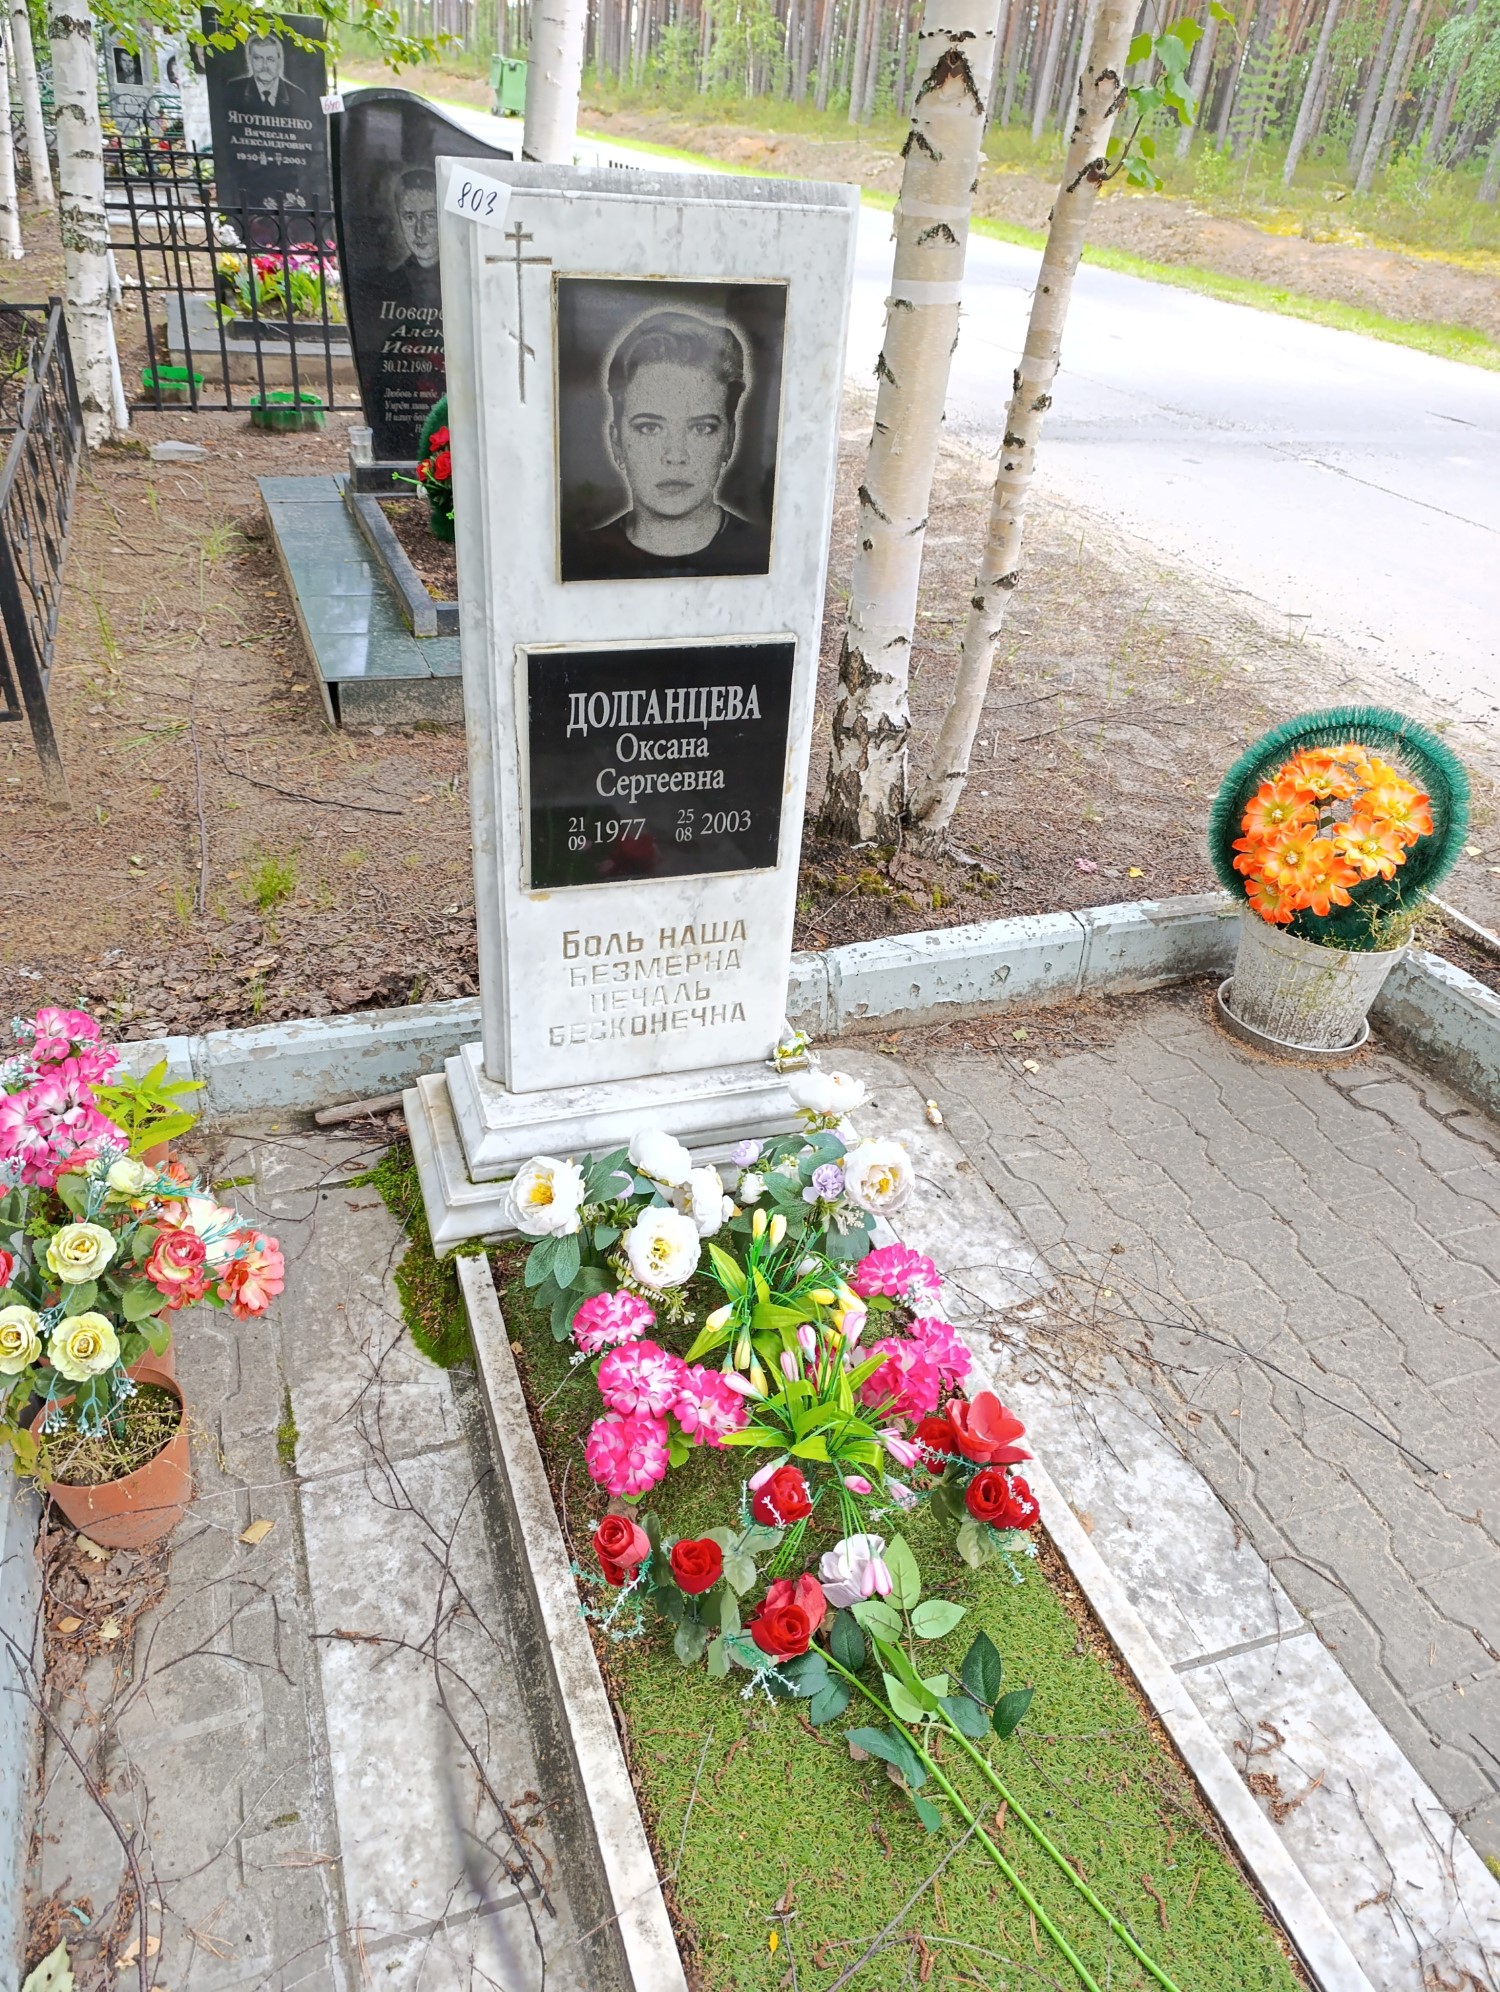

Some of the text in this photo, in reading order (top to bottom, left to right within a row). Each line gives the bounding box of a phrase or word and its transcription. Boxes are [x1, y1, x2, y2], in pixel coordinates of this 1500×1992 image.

[227, 110, 313, 130] ЯГОТИНЕНКО
[457, 181, 498, 216] 803
[381, 359, 433, 373] 30.12.1980
[566, 684, 762, 738] ДОЛГАНЦЕВА
[615, 732, 710, 763] Оксана
[595, 767, 726, 804] Сергеевна
[567, 808, 752, 851] 21 09 1977 25 08 2003
[659, 919, 747, 950] НАША
[569, 948, 741, 988] БЕЗМЕРНА
[590, 980, 711, 1014] ПЕЧАЛЬ
[548, 1002, 747, 1048] БЕСКОНЕЧНА
